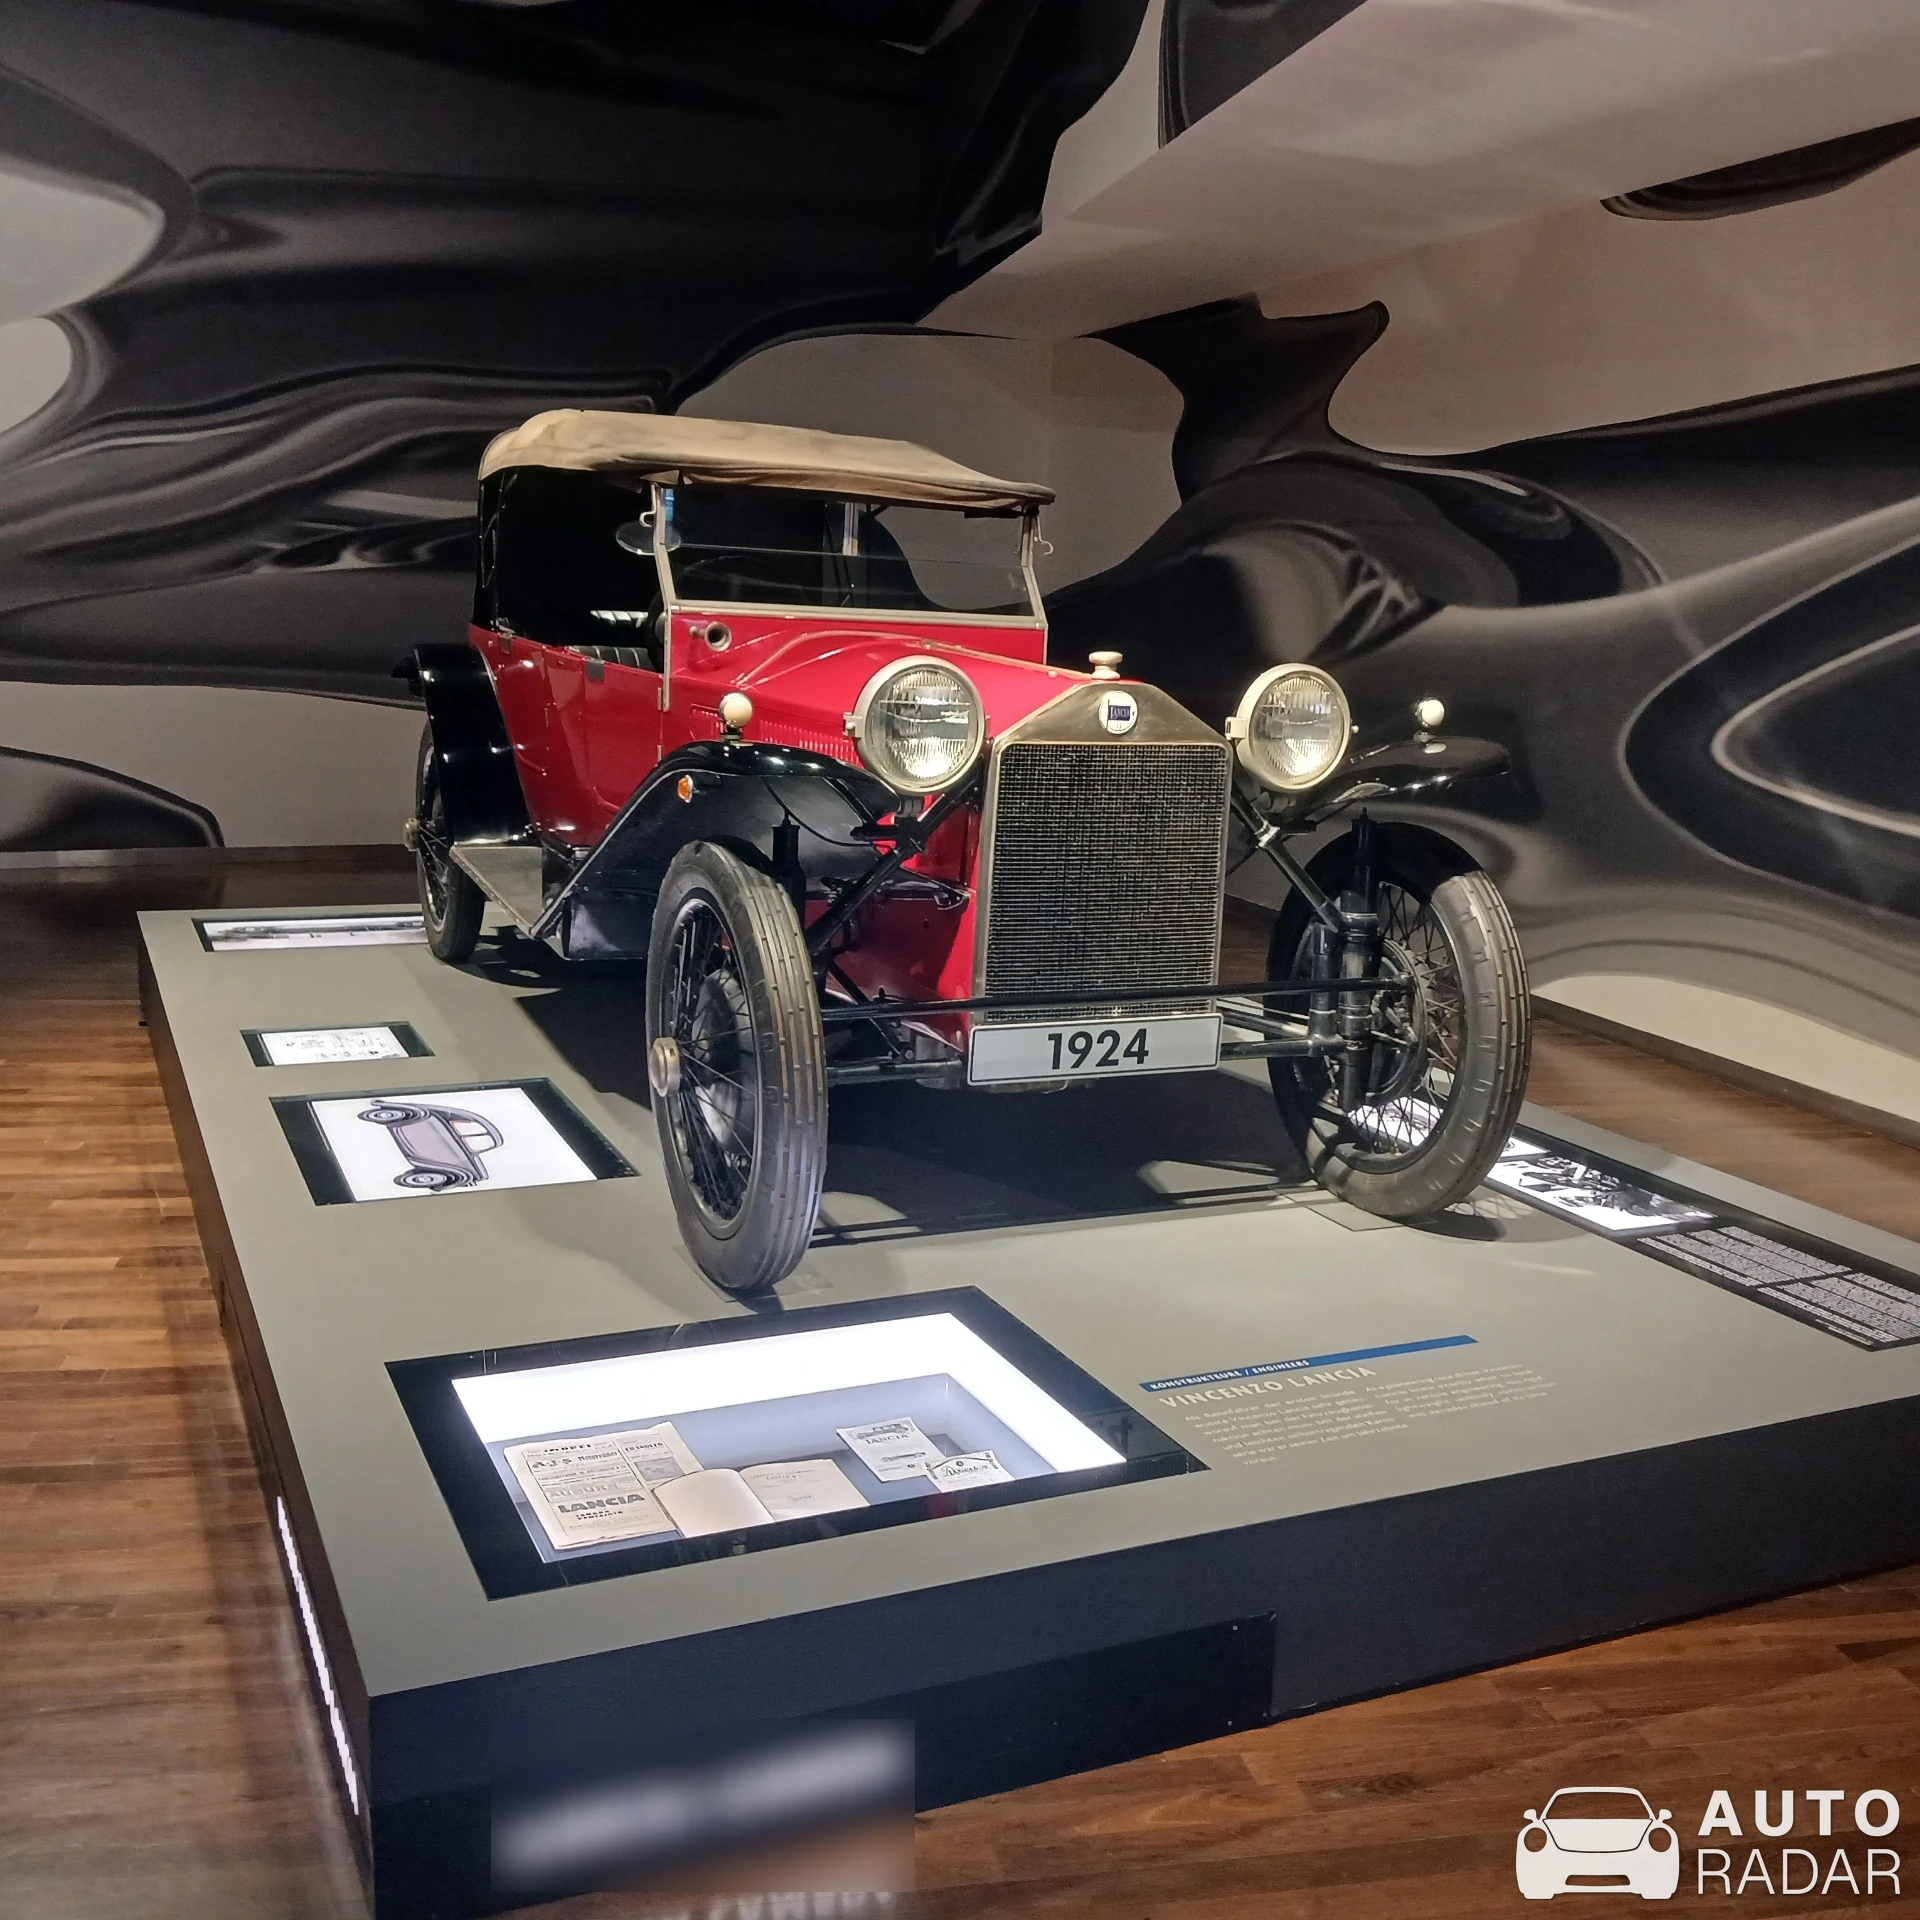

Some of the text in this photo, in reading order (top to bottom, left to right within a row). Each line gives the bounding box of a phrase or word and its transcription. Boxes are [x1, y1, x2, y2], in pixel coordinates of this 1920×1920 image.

[1048, 1028, 1149, 1070] 1924
[1252, 1360, 1310, 1375] ENGINEERS
[1159, 1367, 1377, 1408] VINCENZO LANCIA
[865, 1434, 909, 1445] LANCIA
[557, 1493, 646, 1513] LANCIA
